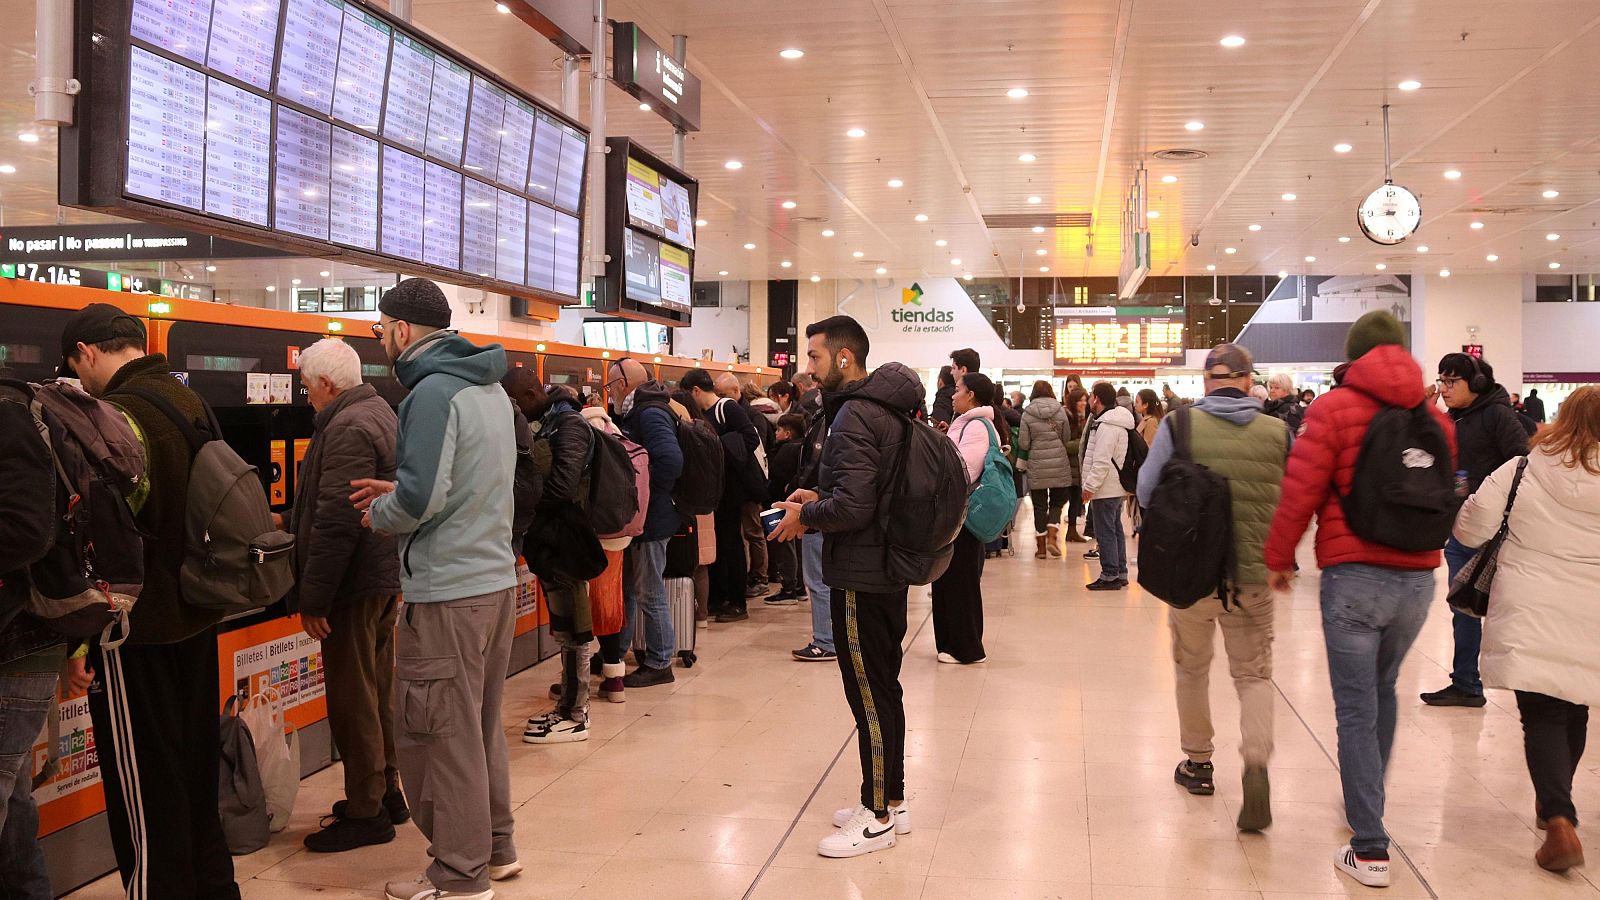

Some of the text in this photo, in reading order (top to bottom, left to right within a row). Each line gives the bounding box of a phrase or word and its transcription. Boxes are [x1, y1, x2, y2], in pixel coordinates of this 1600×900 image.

[8, 238, 24, 250] No
[26, 240, 57, 253] pasar
[66, 236, 82, 250] No
[891, 308, 954, 322] tiendas
[914, 324, 920, 332] la
[922, 324, 954, 332] estación
[236, 650, 263, 667] Billetes
[270, 640, 294, 656] Bitllets
[59, 702, 90, 720] itllet
[72, 735, 84, 749] R2
[72, 756, 85, 771] R7
[87, 750, 98, 765] R8
